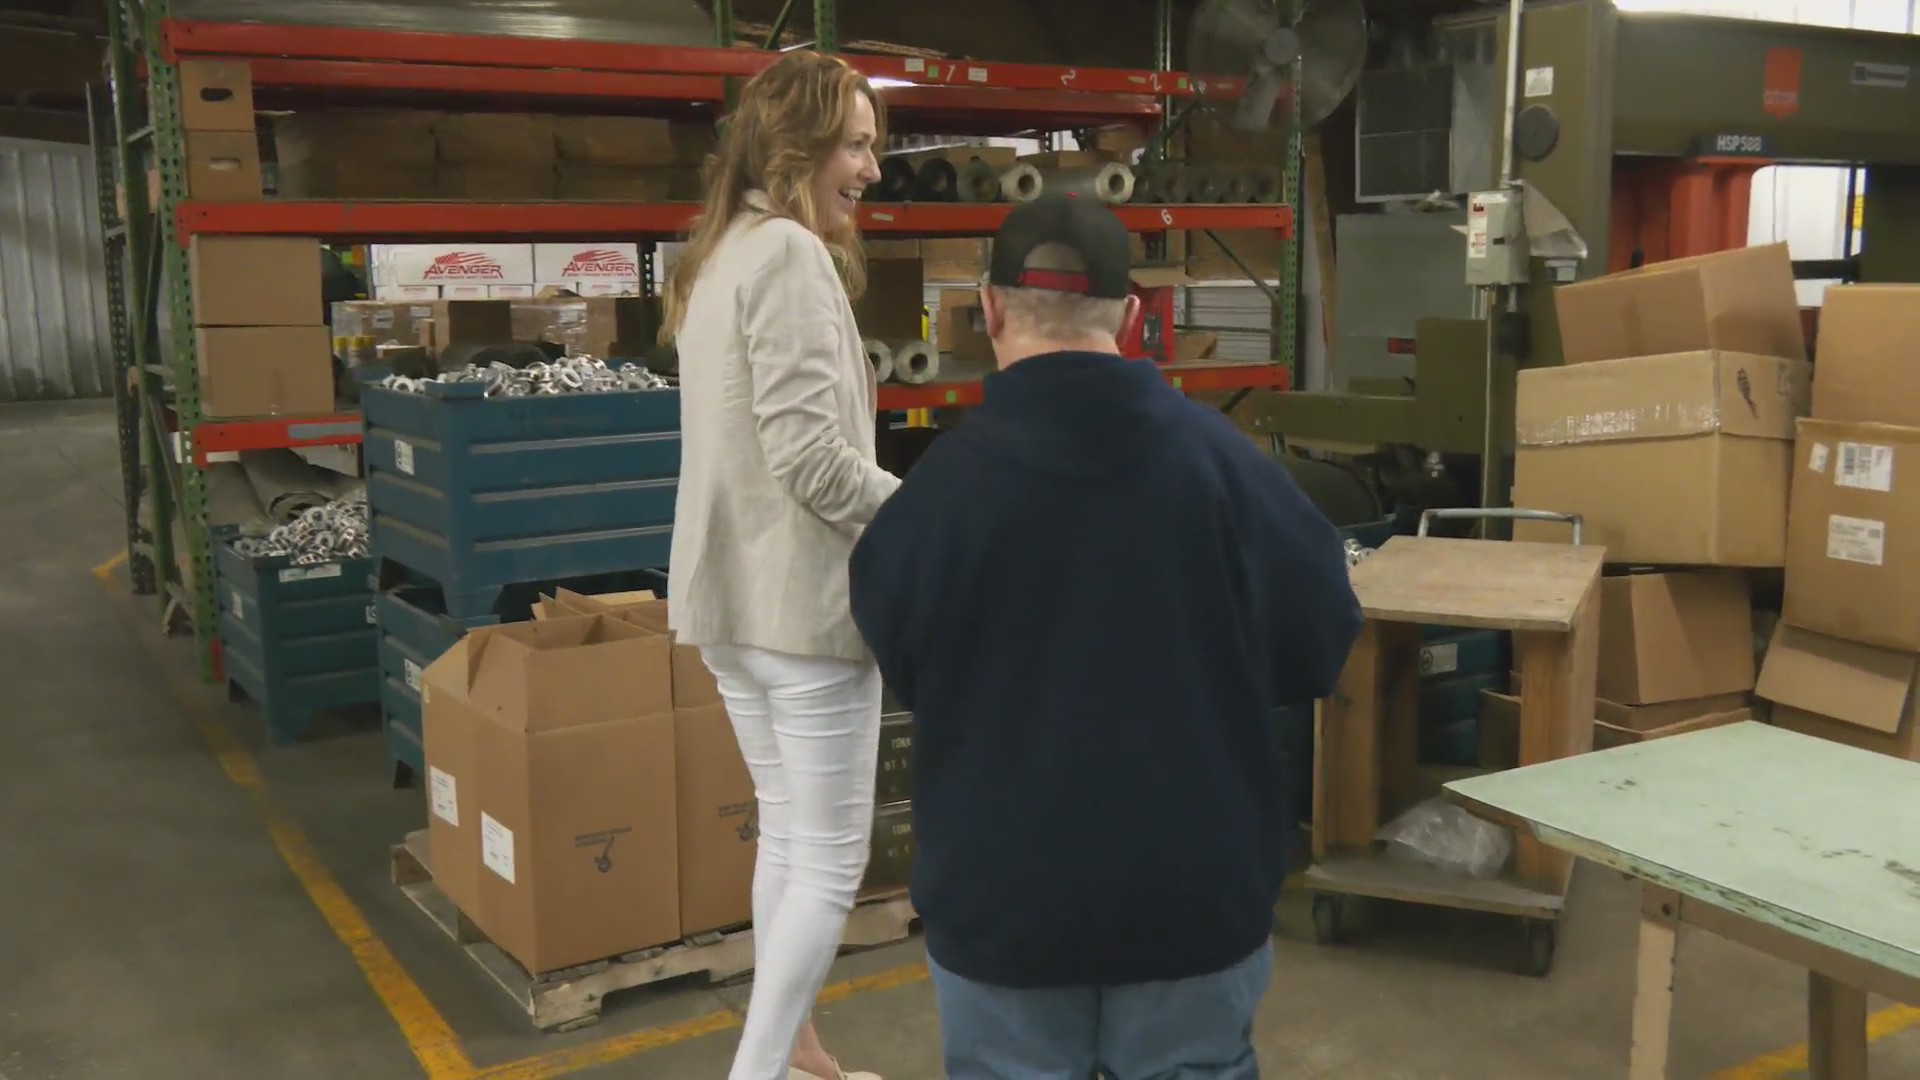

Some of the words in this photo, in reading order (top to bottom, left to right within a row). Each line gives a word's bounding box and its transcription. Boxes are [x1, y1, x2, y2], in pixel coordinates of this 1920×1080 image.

[1161, 209, 1173, 226] 6
[422, 263, 504, 280] AVENGER
[561, 260, 637, 277] AVENGER
